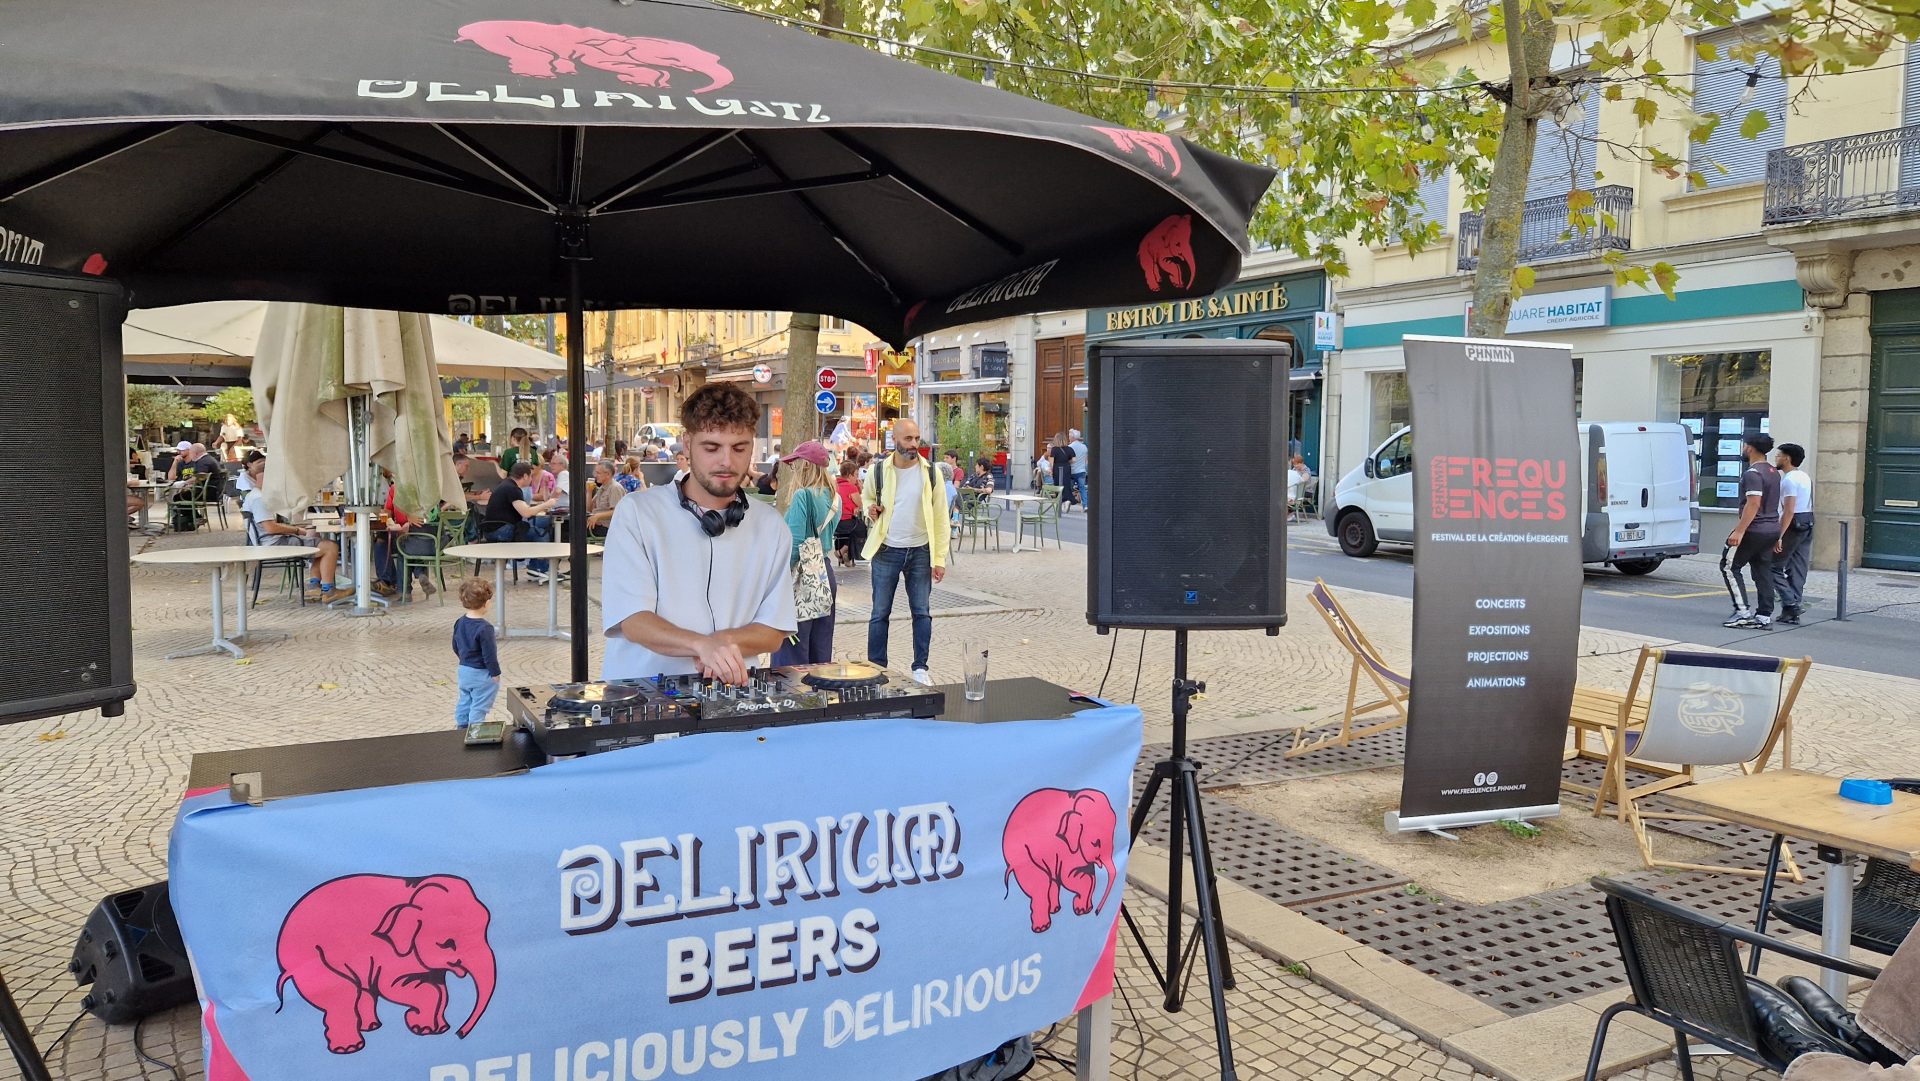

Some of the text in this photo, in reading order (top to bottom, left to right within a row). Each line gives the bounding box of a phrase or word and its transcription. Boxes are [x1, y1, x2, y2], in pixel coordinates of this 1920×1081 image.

[1106, 282, 1289, 331] BISTROT DE SAINTÉ
[1507, 301, 1603, 321] QUARE HABITAT
[1569, 314, 1600, 322] AGRICOLE
[1465, 344, 1515, 363] PHNMN
[820, 375, 836, 383] STOP
[1448, 456, 1567, 489] FREQU
[1450, 489, 1567, 521] ENCES
[1432, 532, 1569, 543] FESTIVAL DE LA CRÉATION ÉMERGENTE
[1475, 598, 1526, 609] CONCERTS
[1469, 625, 1530, 635] EXPOSITIONS
[1467, 651, 1529, 663] PROJECTIONS
[1466, 676, 1526, 688] ANIMATIONS
[737, 701, 781, 711] Pioneer
[1441, 784, 1526, 796] WWW.FREQUENCES.PHNMN.FR
[557, 801, 965, 936] DELIRIUM
[666, 907, 881, 1004] BEERS
[823, 952, 1042, 1049] DELIRIOUS
